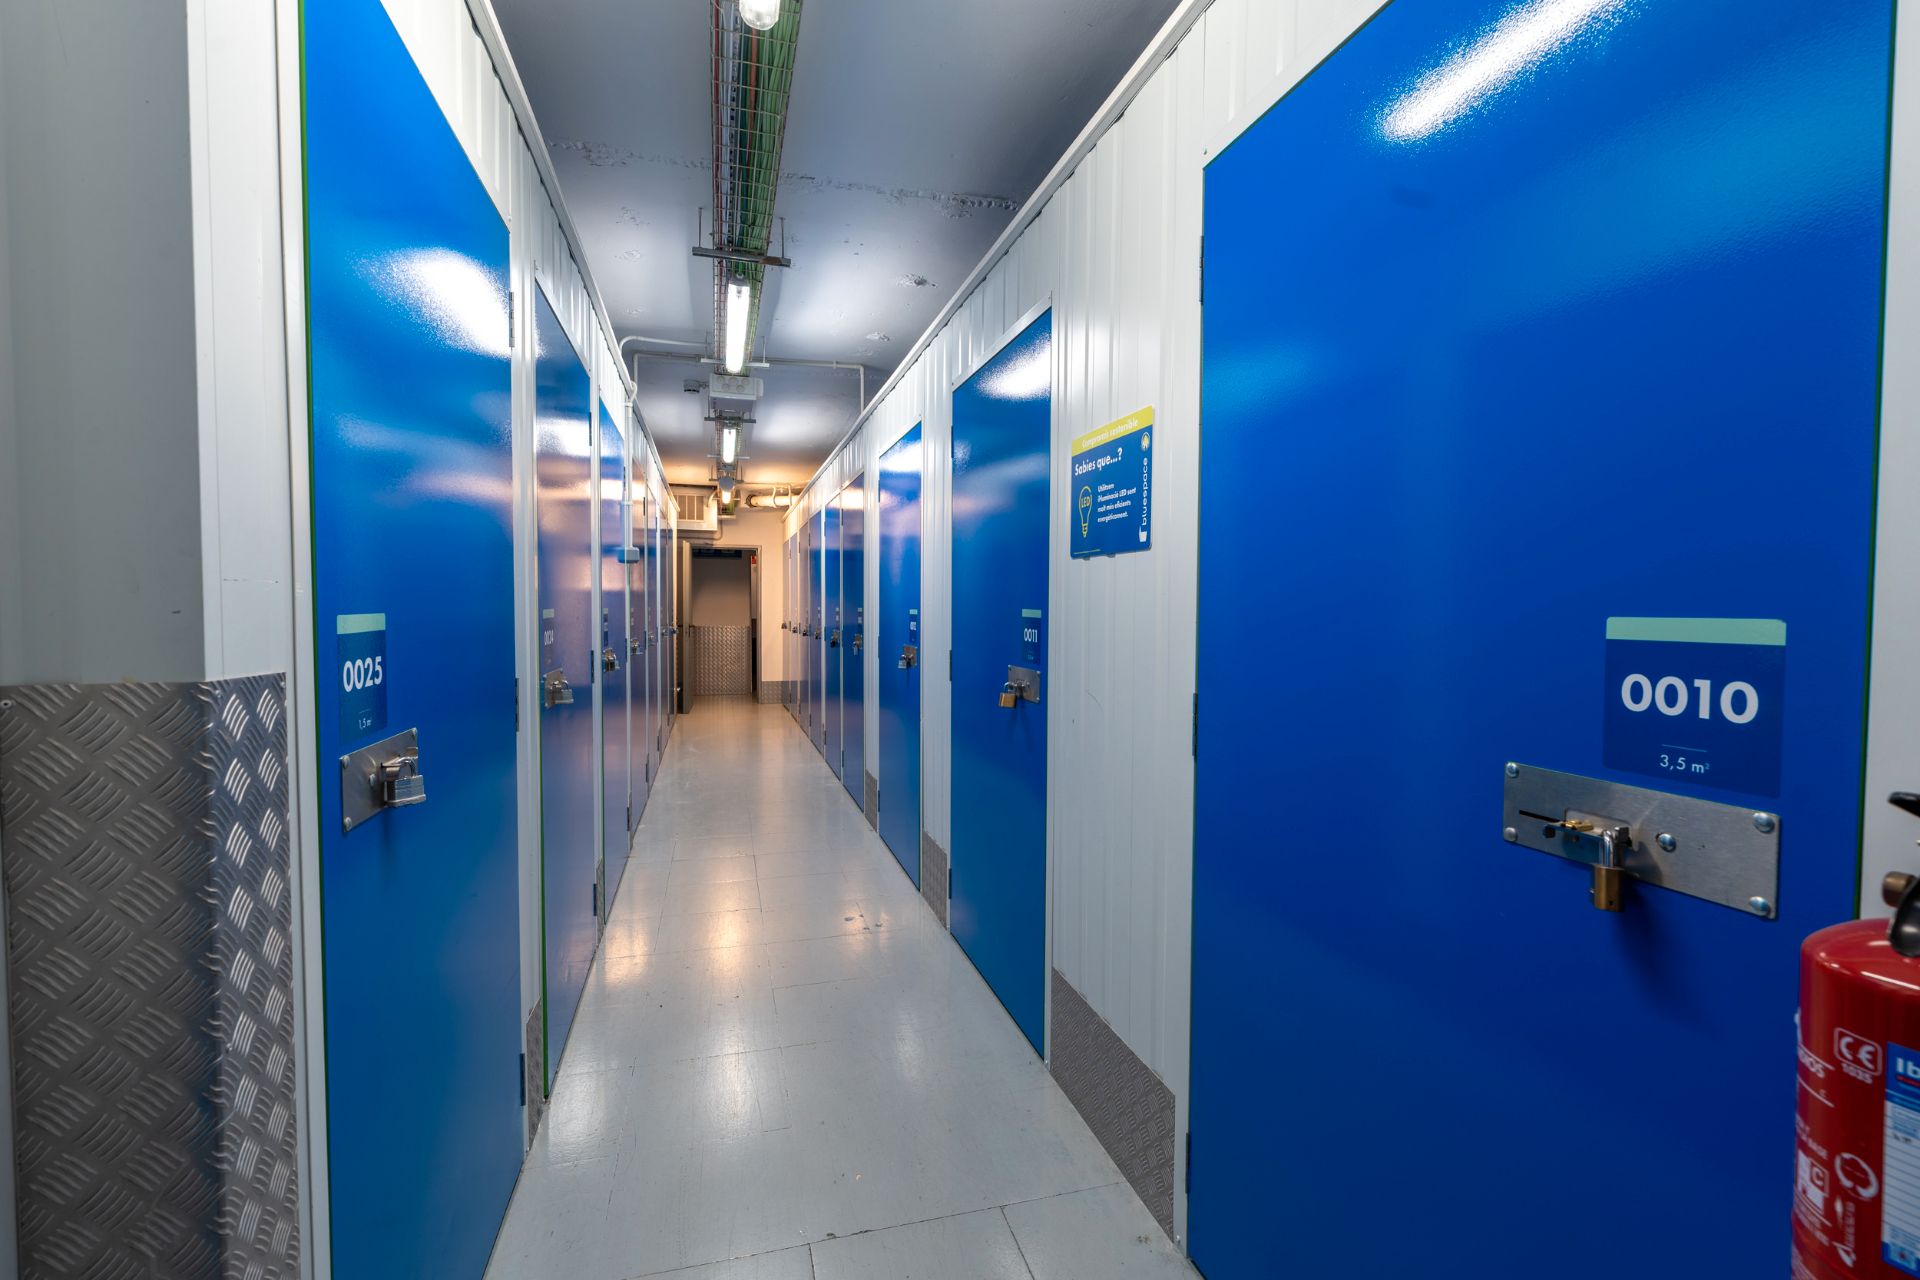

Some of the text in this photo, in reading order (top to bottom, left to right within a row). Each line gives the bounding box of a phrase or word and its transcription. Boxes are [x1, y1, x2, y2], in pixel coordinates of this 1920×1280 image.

[1075, 447, 1122, 475] Sabies que...?
[1023, 628, 1038, 643] 0011
[343, 655, 383, 692] 0025
[1621, 673, 1759, 724] 0010
[1659, 754, 1686, 771] 3,5
